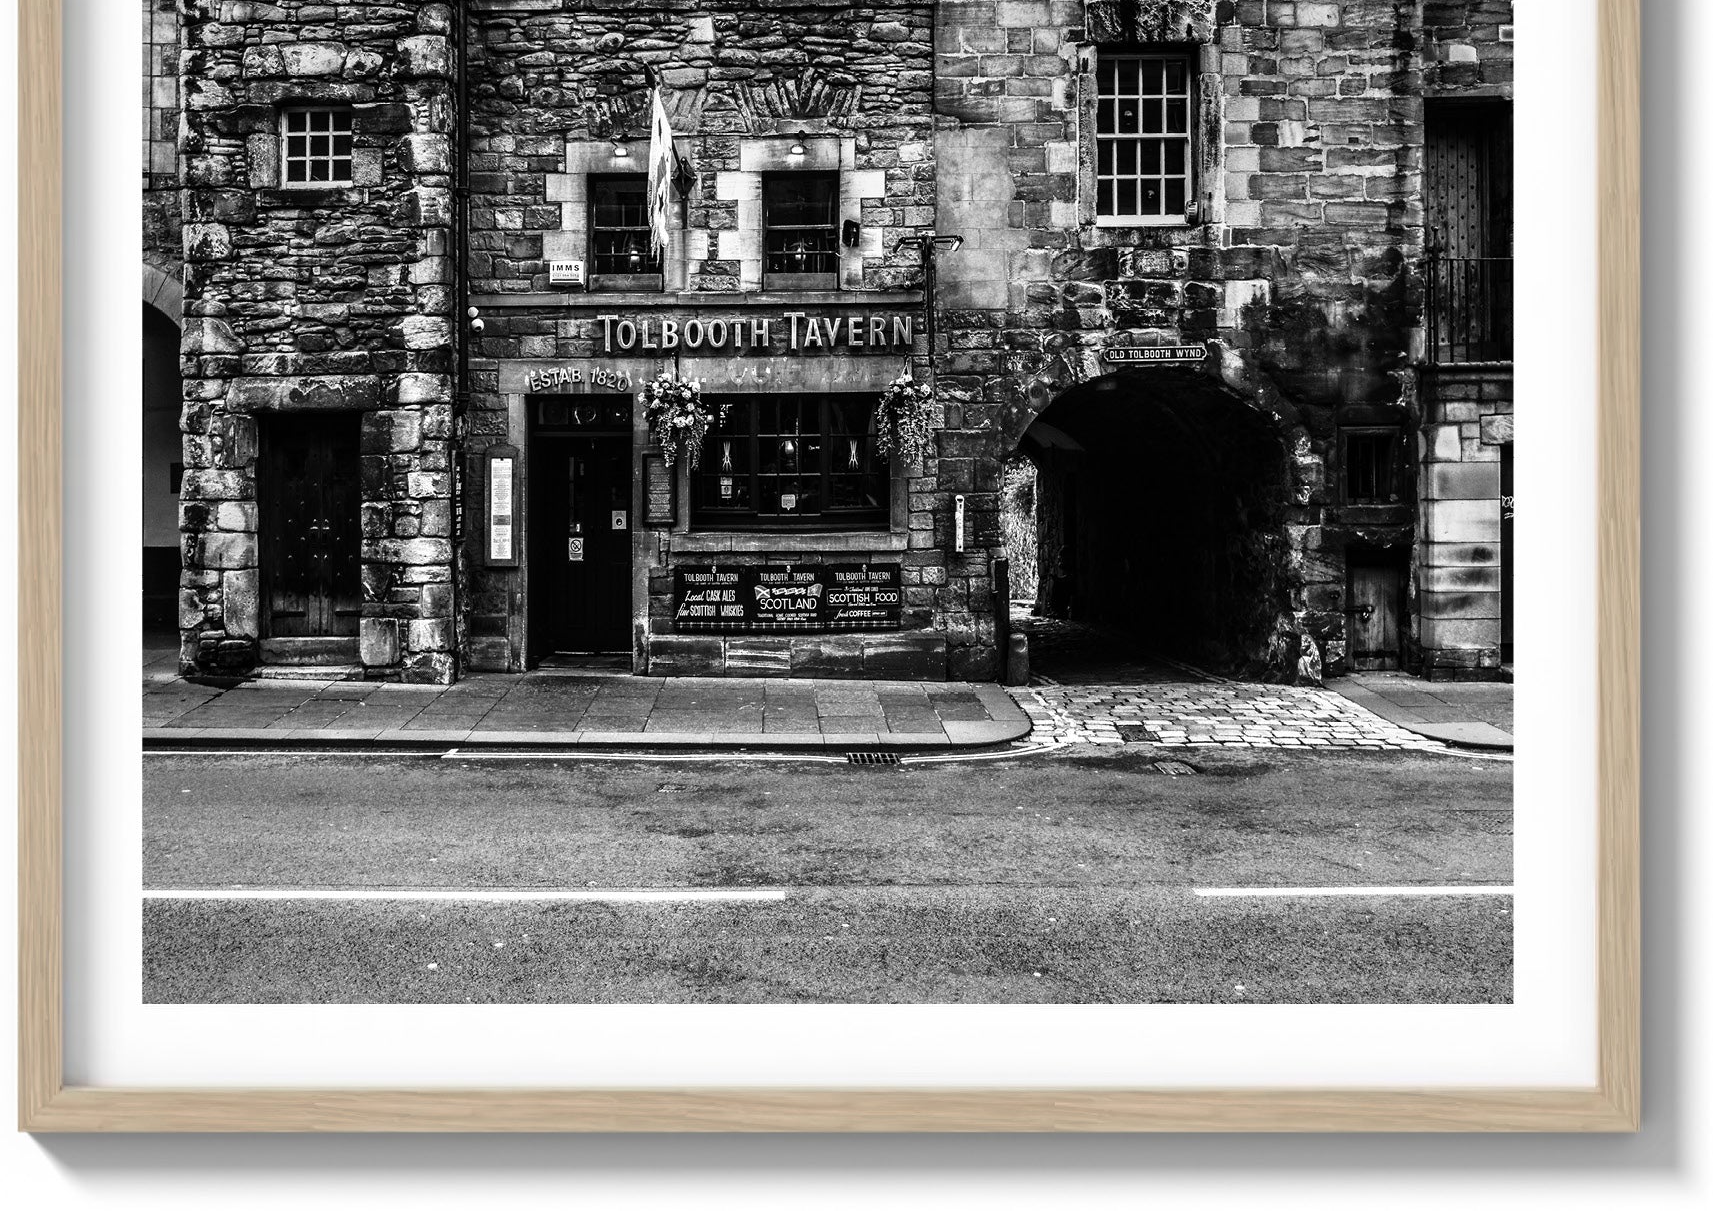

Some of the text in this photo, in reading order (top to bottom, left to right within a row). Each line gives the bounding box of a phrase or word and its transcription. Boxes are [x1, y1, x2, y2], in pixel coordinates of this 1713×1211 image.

[552, 264, 580, 272] IMMS
[597, 311, 913, 353] TOLBOOTH TAVERN
[1109, 348, 1201, 360] OLD TOLBOOTH WYND
[530, 367, 629, 392] ESTAB. 1820
[683, 573, 739, 582] TOLBOOTH TAVERN
[759, 572, 815, 582] TOLBOOTH TAVERN
[834, 571, 891, 581] TOLBOOTH TAVERN
[684, 589, 736, 602] Local CASK ALES
[828, 592, 898, 604] SCOTTISH FOOD
[759, 598, 817, 610] SCOTLAND
[689, 604, 716, 617] SCOTTISH
[848, 610, 871, 618] COFFEE
